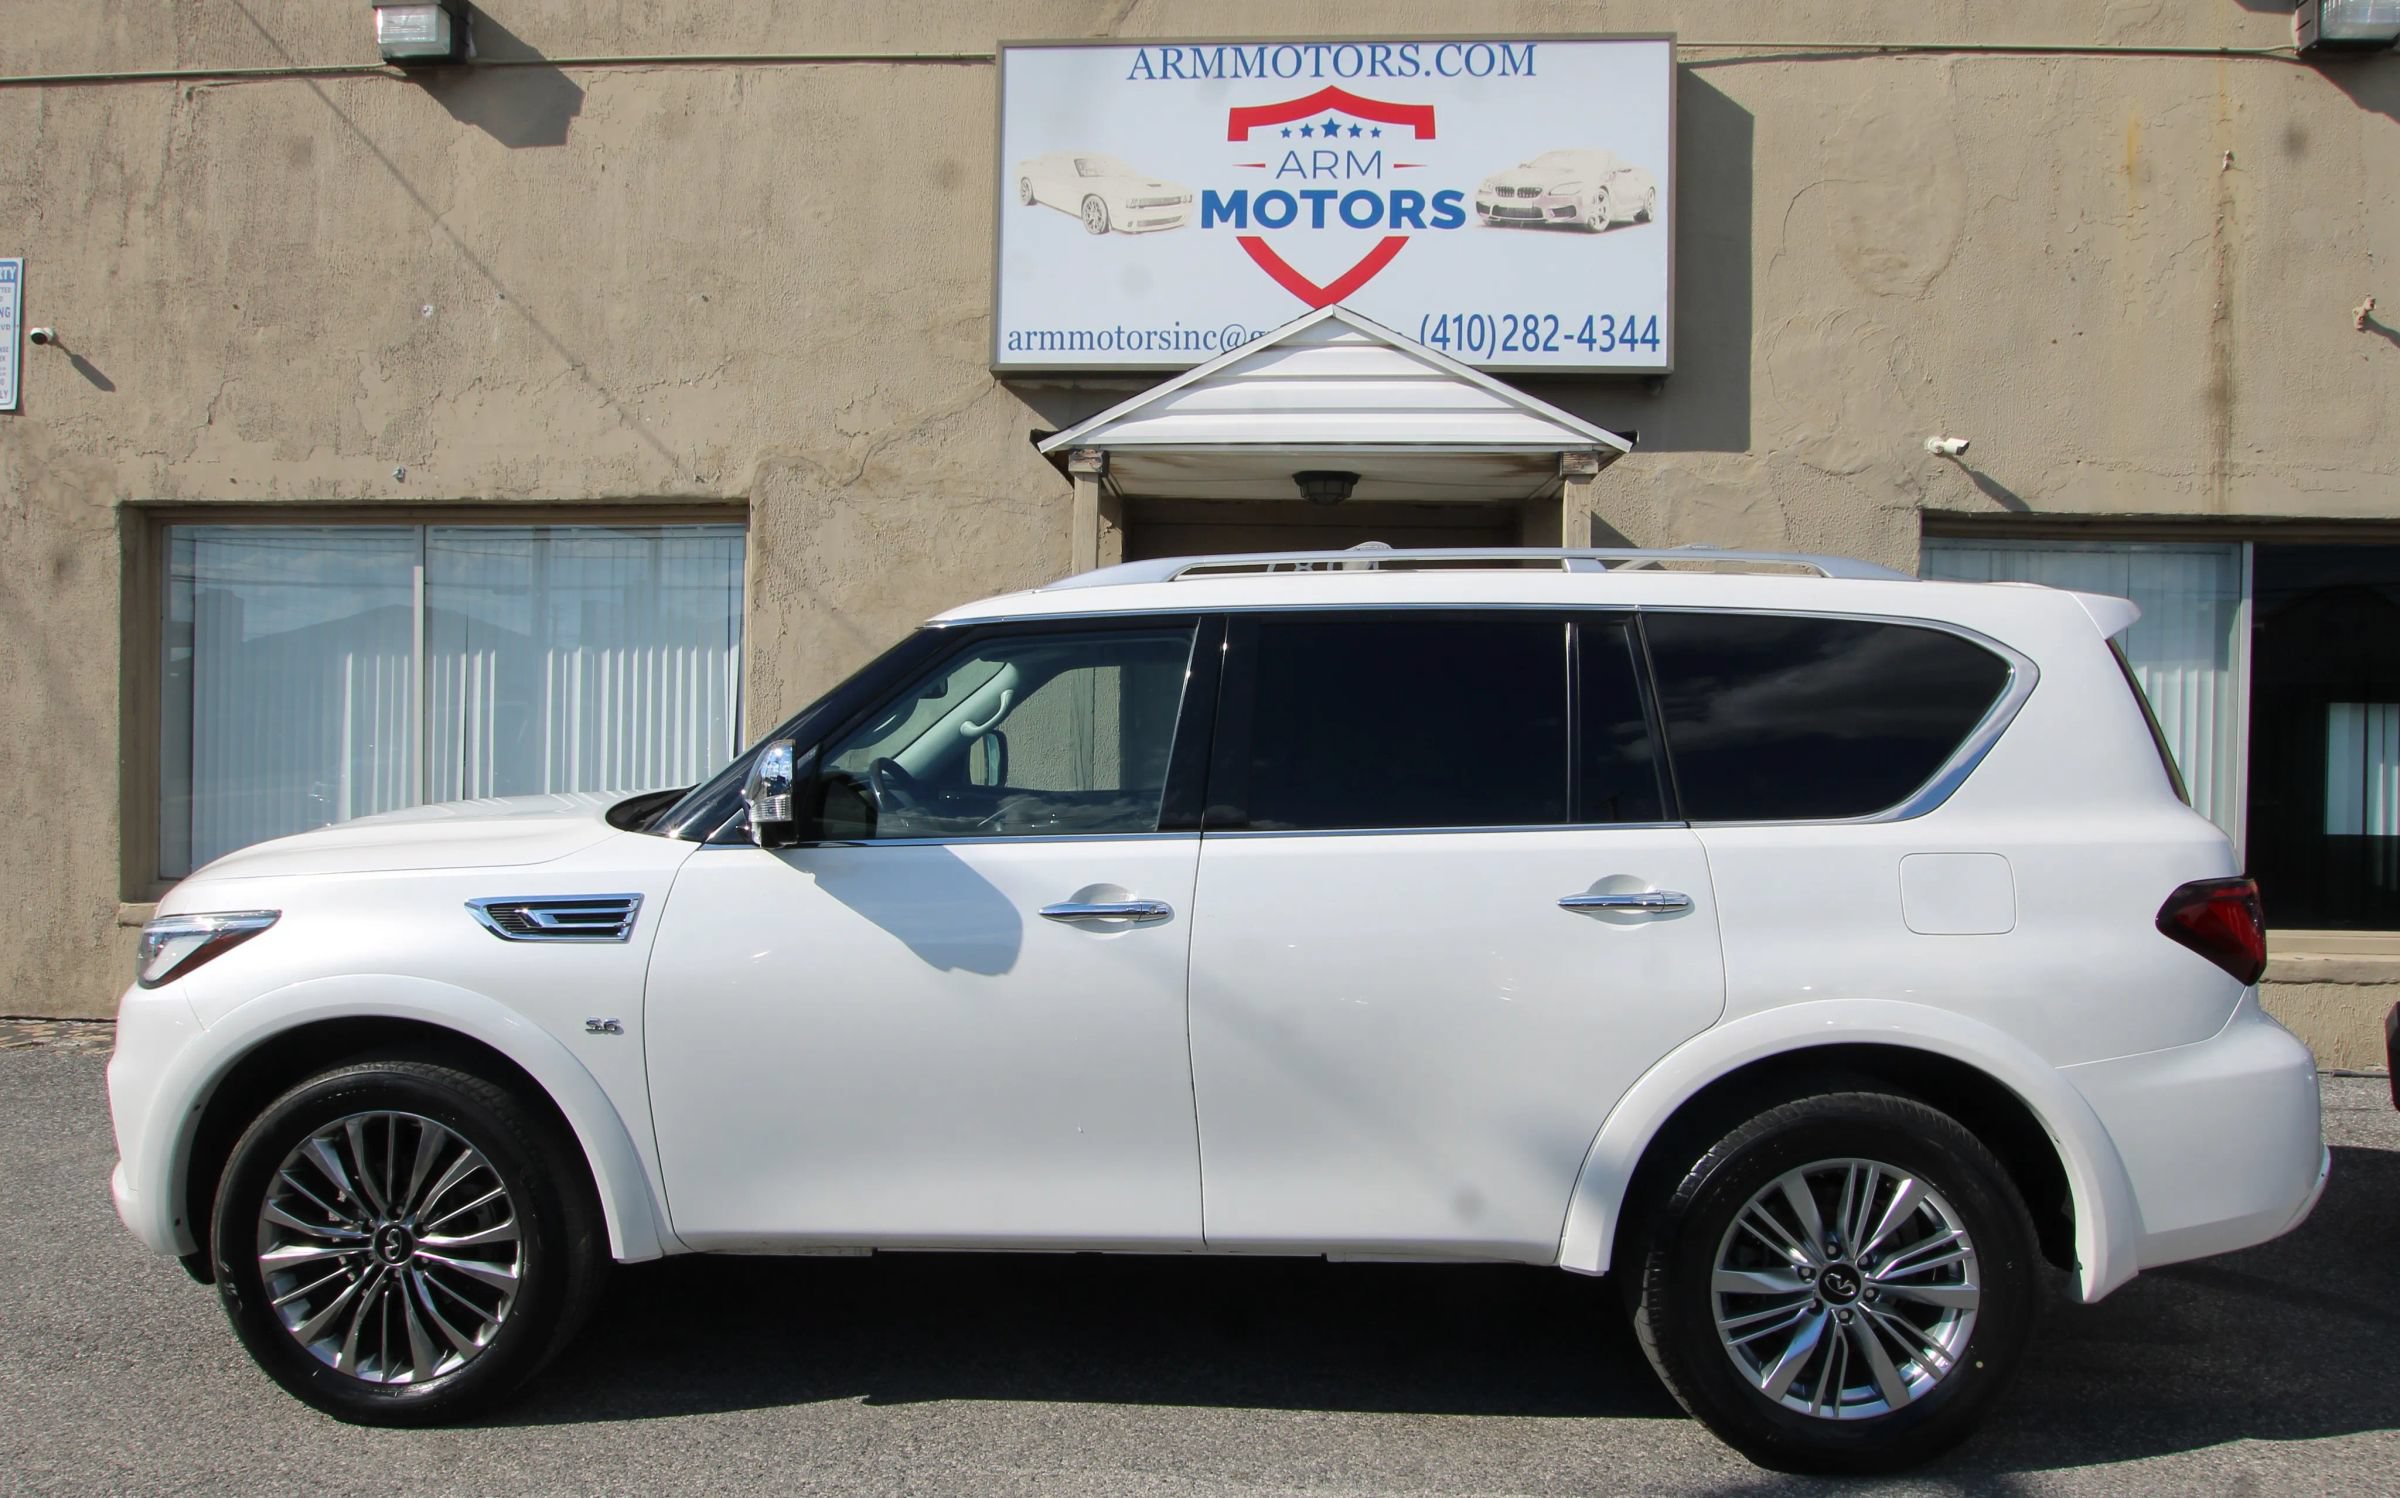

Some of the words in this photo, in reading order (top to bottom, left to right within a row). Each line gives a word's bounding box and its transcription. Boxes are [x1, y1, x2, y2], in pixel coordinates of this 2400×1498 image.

[1126, 42, 1537, 81] ARMMOTORS.COM
[1275, 149, 1383, 180] ARM
[1200, 189, 1467, 231] MOTORS
[1420, 313, 1662, 360] (410)282-4344
